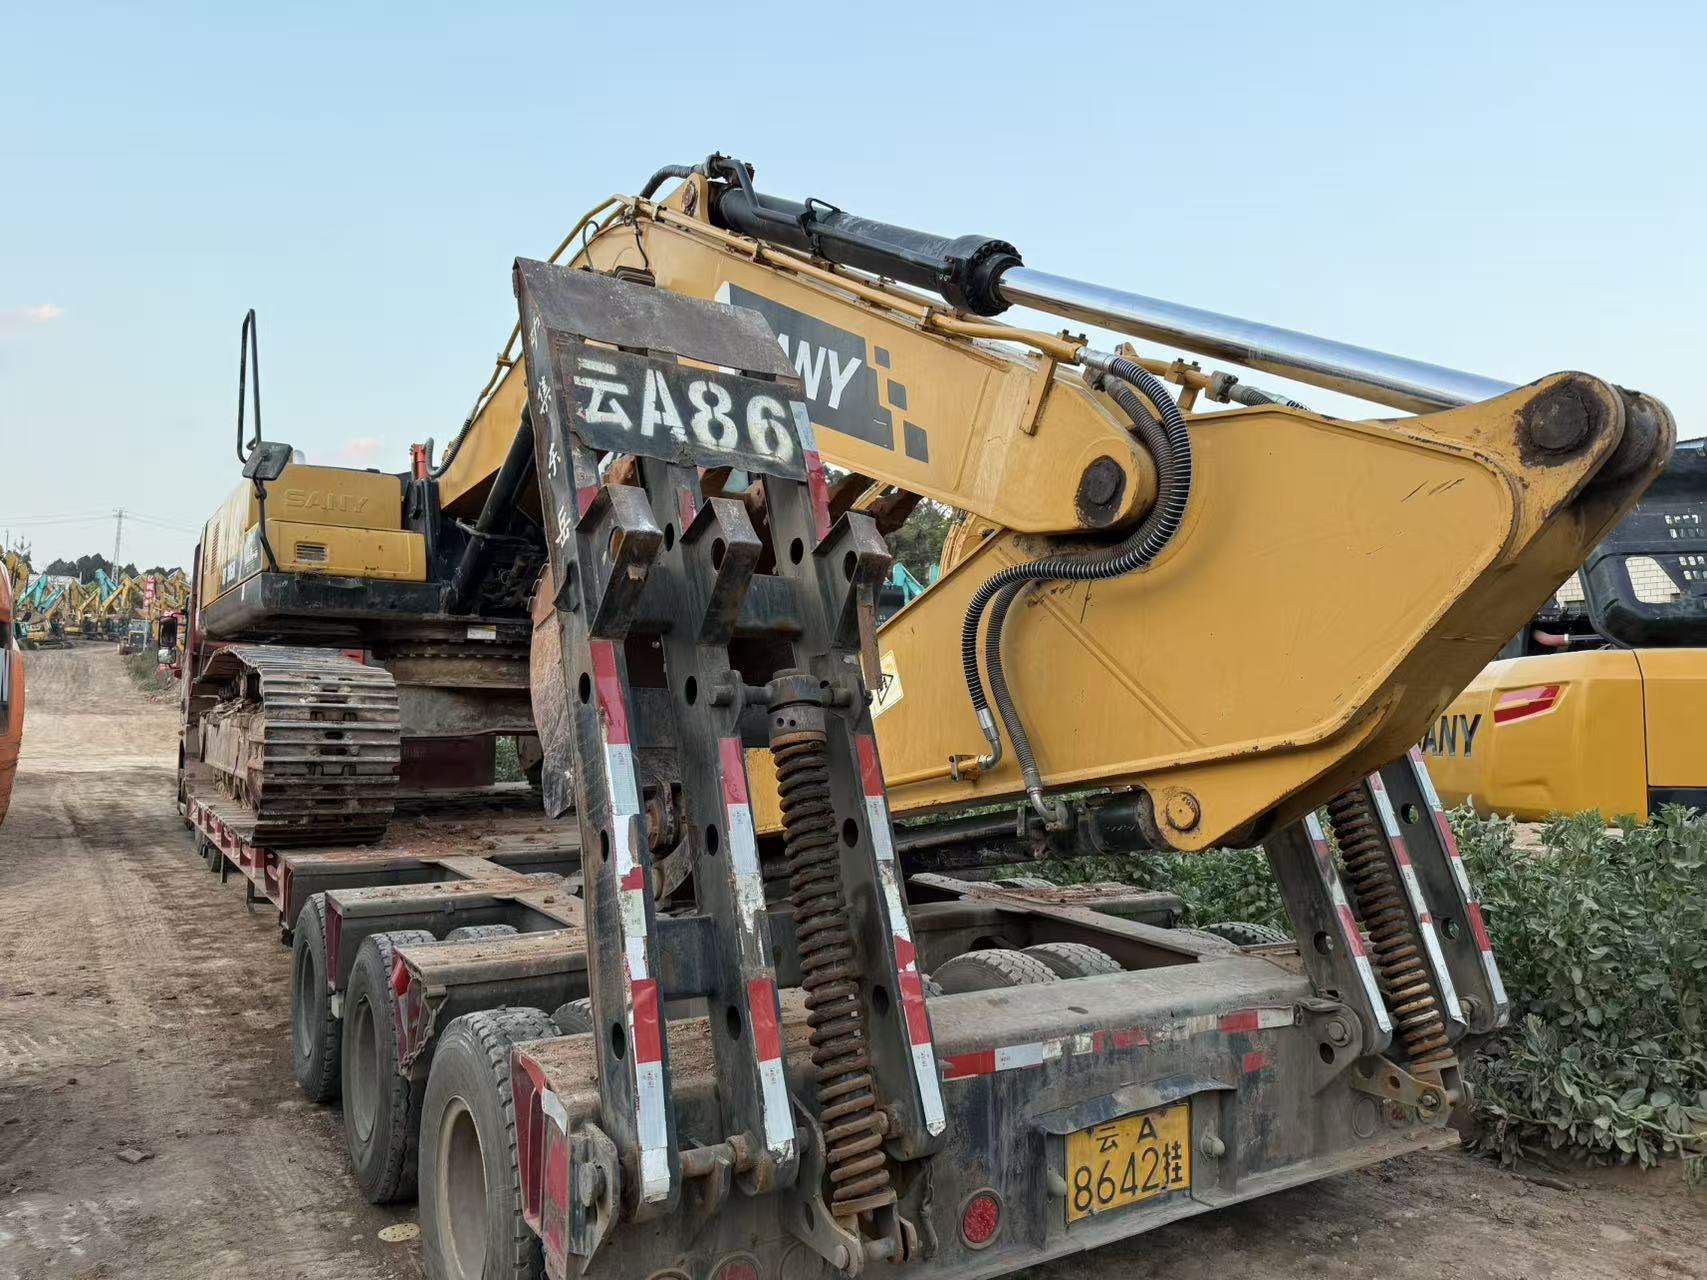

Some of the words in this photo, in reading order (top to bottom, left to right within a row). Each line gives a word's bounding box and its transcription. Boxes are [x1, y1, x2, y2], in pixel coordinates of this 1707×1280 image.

[573, 357, 793, 463] 云A86
[283, 488, 369, 513] SANY
[1420, 713, 1482, 757] ANY
[1073, 1140, 1183, 1212] 8642挂
